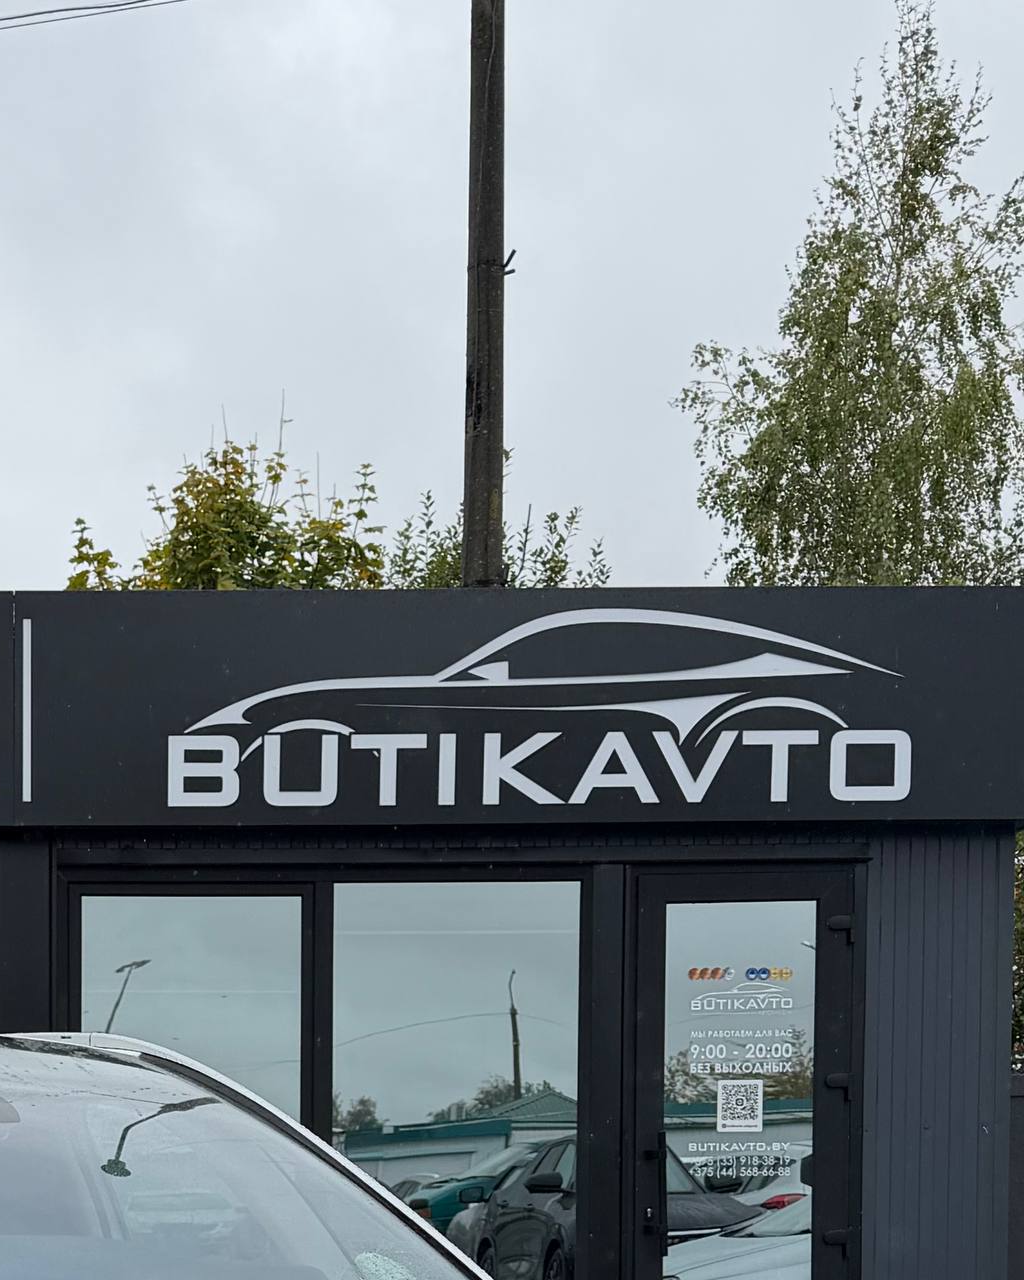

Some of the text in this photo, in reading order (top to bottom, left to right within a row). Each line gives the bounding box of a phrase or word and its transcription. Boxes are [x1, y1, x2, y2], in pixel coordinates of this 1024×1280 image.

[167, 729, 912, 808] BUTIKAVTO
[690, 998, 793, 1010] BUTIKAVTO
[690, 1029, 793, 1038] МЫ РАБОТАЕМ ДЛЯ ВАС
[690, 1044, 726, 1059] 9:00
[745, 1043, 792, 1059] 20:00
[690, 1062, 792, 1074] БЕЗ ВЫХОДНЫХ
[688, 1142, 791, 1152] BUTIKAVTO.BY
[717, 1156, 736, 1167] (33)
[740, 1156, 791, 1166] 918-38-19
[717, 1167, 736, 1179] (44)
[740, 1167, 791, 1177] 568-66-88
